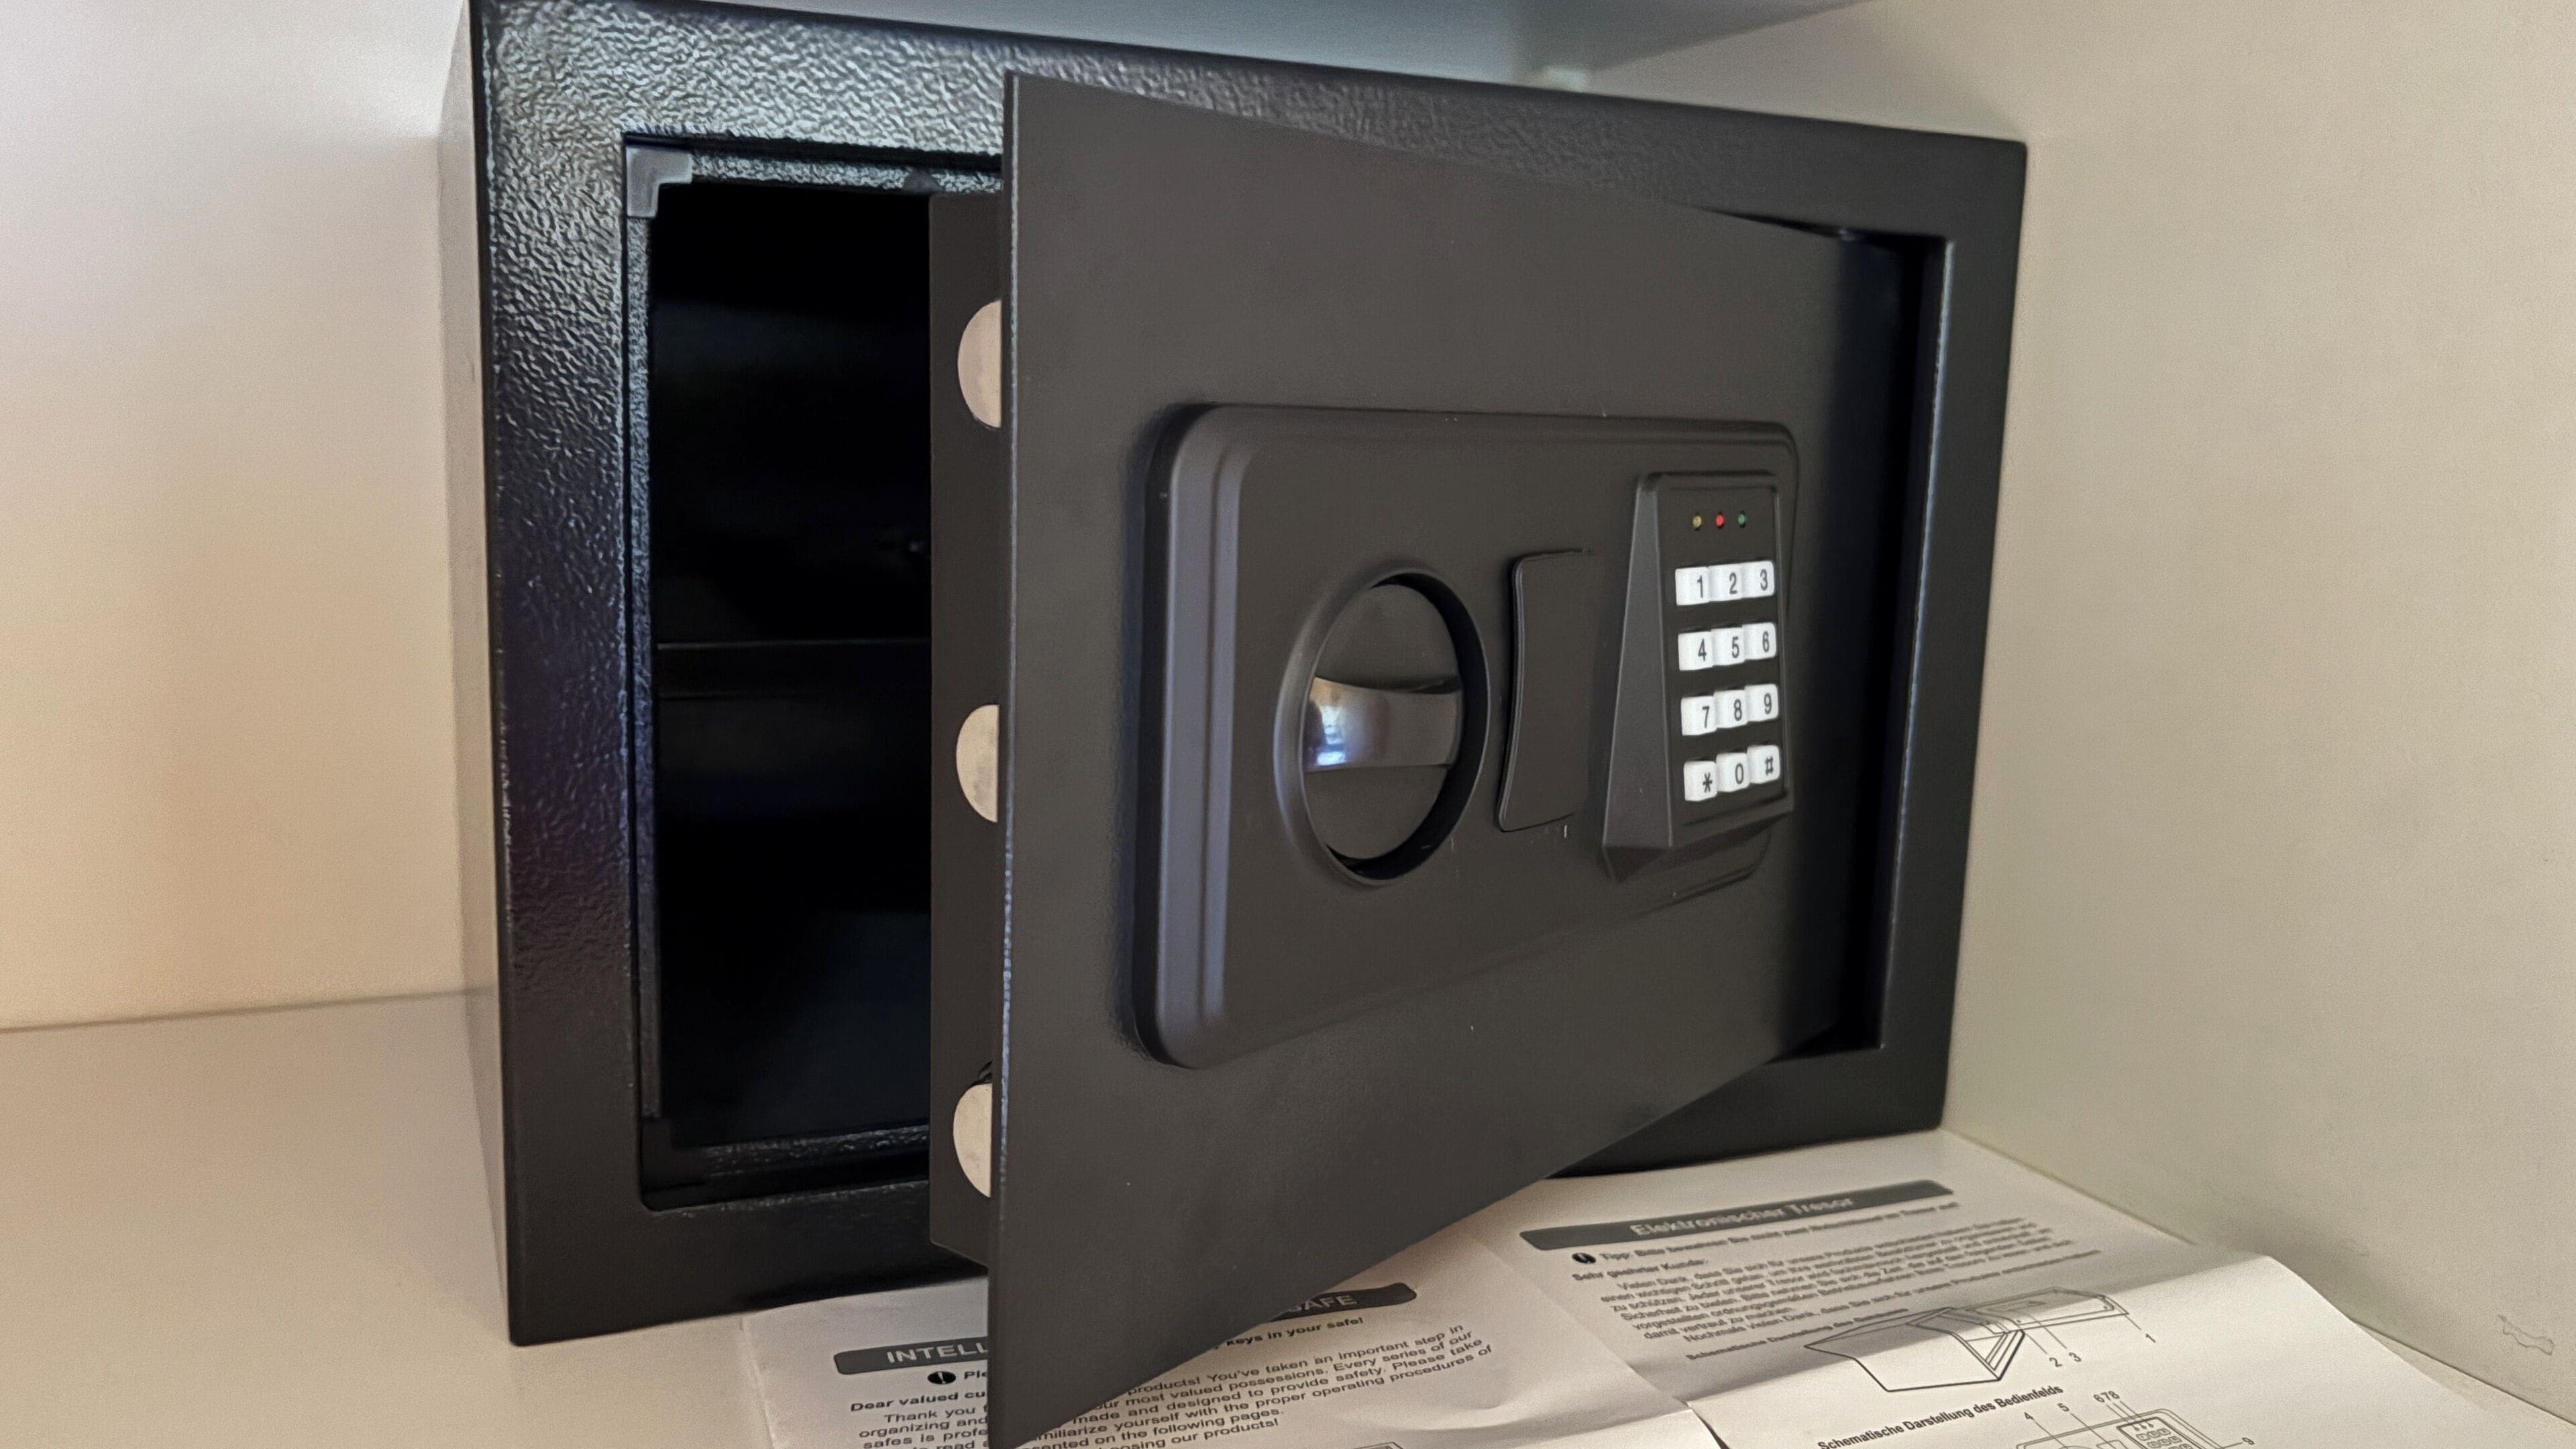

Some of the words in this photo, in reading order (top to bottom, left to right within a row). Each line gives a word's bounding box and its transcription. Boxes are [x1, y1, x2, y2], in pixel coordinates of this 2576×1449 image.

[1697, 574, 1704, 598] 1
[1728, 572, 1737, 595] 2
[1760, 569, 1768, 591] 3
[1697, 639, 1707, 661] 4
[1731, 636, 1740, 659] 5
[1762, 631, 1770, 653] 6
[1701, 706, 1710, 729] 7
[1733, 699, 1742, 722] 8
[1764, 692, 1772, 715] 9
[1735, 763, 1744, 785] 0
[1764, 756, 1774, 775] #
[1226, 1335, 1263, 1346] keys
[1267, 1331, 1283, 1340] in
[1286, 1324, 1322, 1337] your
[1326, 1317, 1364, 1329] safe!
[1126, 1394, 1165, 1406] most
[1170, 1385, 1223, 1399] valued
[1229, 1367, 1328, 1392] possessions.
[1334, 1358, 1376, 1372] Every
[1382, 1348, 1426, 1362] series
[1431, 1342, 1446, 1352] of
[1449, 1331, 1472, 1345] our
[1128, 1377, 1201, 1396] products!
[1206, 1368, 1260, 1382] You've
[1265, 1360, 1308, 1373] taken
[1314, 1355, 1333, 1364] an
[1338, 1342, 1409, 1360] important
[1414, 1332, 1446, 1346] step
[1449, 1324, 1464, 1334] in
[2049, 1356, 2063, 1368] 2
[2068, 1351, 2082, 1362] 3
[1037, 1426, 1108, 1441] miliarize
[1114, 1412, 1179, 1432] yourself
[1185, 1406, 1218, 1419] with
[1224, 1401, 1249, 1412] the
[1255, 1392, 1306, 1409] proper
[1312, 1377, 1385, 1397] operating
[1389, 1354, 1475, 1382] procedures
[1478, 1344, 1493, 1356] of
[1073, 1411, 1120, 1424] made
[1128, 1405, 1159, 1417] and
[1167, 1391, 1242, 1410] designed
[1248, 1388, 1264, 1397] to
[1271, 1378, 1329, 1396] provide
[1336, 1368, 1386, 1382] safety.
[1392, 1354, 1446, 1371] Please
[1450, 1339, 1483, 1356] take
[850, 1399, 895, 1412] Dear
[899, 1392, 959, 1405] valued
[884, 1410, 938, 1424] Thank
[945, 1407, 975, 1418] you
[2023, 1411, 2035, 1421] 4
[2057, 1402, 2070, 1413] 5
[859, 1421, 950, 1438] organizing
[1095, 1434, 1116, 1445] on
[1121, 1430, 1148, 1441] the
[1153, 1417, 1226, 1436] following
[1230, 1408, 1284, 1424] pages.
[1171, 1433, 1199, 1444] our
[1203, 1418, 1279, 1440] products!
[1817, 1424, 1904, 1449] Schematische
[1902, 1405, 1975, 1432] Darstellung
[1973, 1399, 1997, 1413] des
[1994, 1385, 2064, 1409] Bedienfelds
[863, 1438, 912, 1449] safes
[920, 1434, 935, 1443] is
